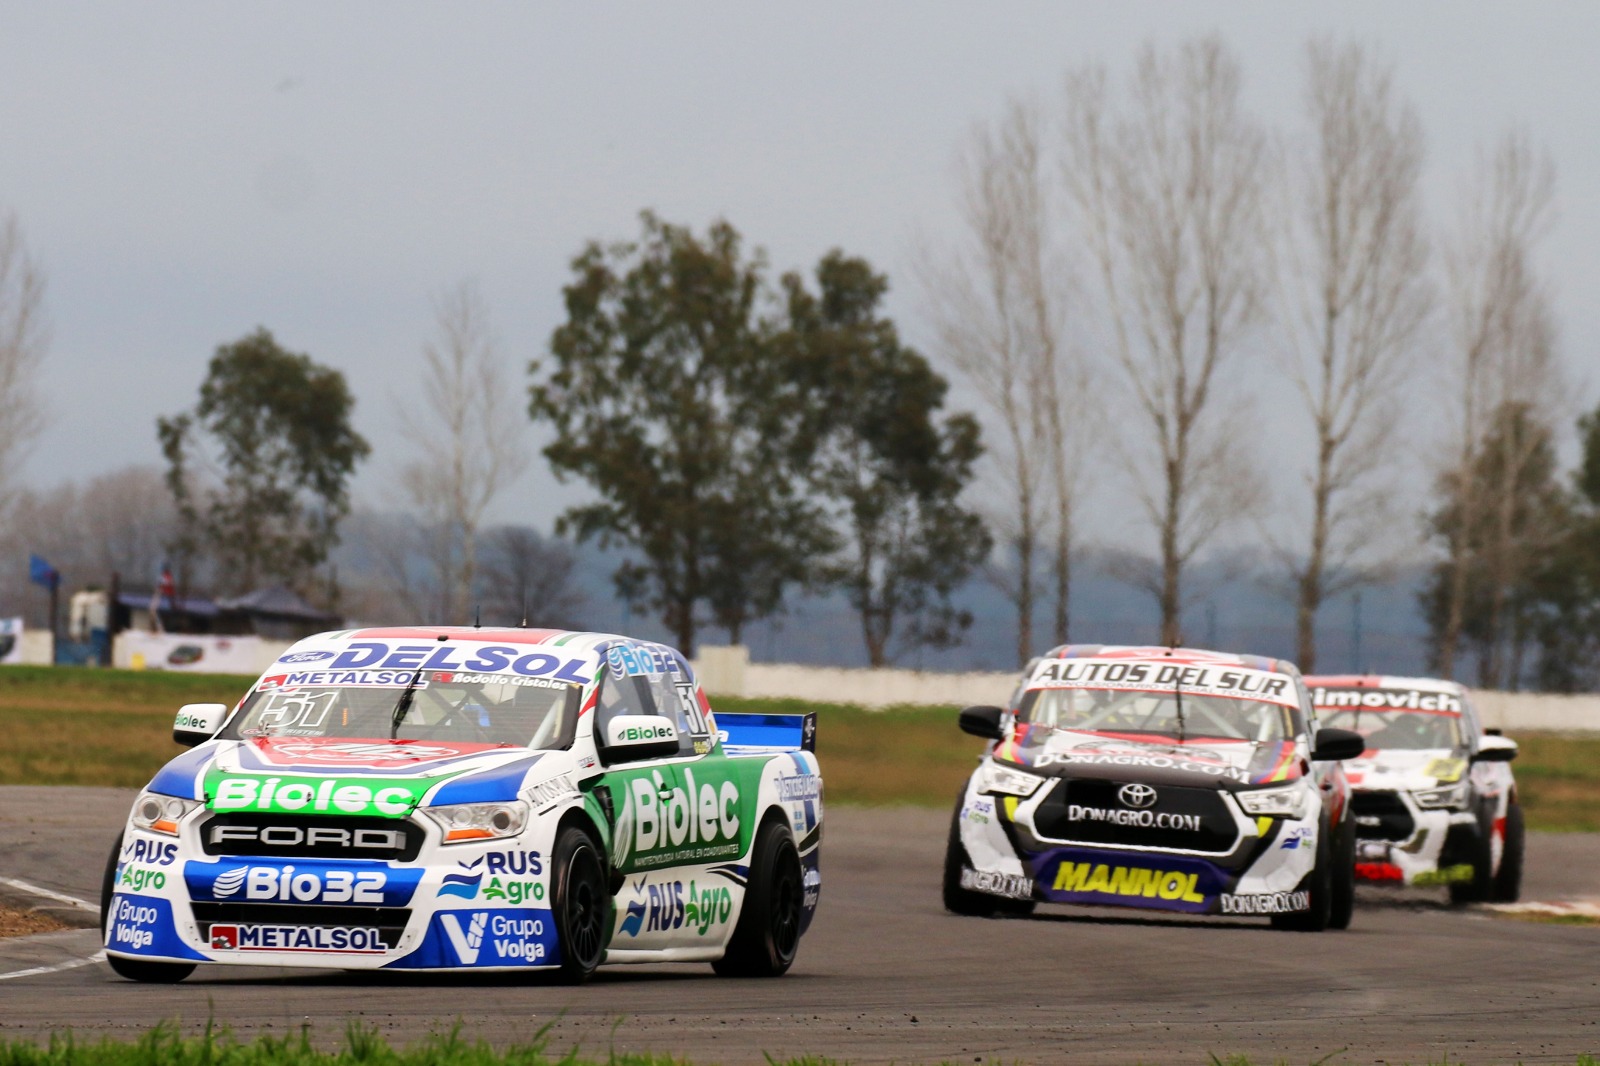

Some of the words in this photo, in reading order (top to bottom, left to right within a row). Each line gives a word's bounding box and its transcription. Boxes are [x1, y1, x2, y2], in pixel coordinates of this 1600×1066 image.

[286, 651, 323, 663] Ford
[329, 643, 591, 684] DELSOL
[287, 672, 426, 685] METALSOL
[452, 673, 507, 685] Rodolfo
[511, 676, 567, 691] Cristales
[1035, 664, 1151, 682] AUTOS
[1154, 666, 1208, 686] DEL
[1216, 672, 1287, 696] SUR
[1162, 684, 1213, 694] OICIAL
[258, 691, 338, 728] 51
[677, 685, 707, 734] 51
[1309, 687, 1462, 712] imovich
[626, 726, 673, 741] Biolec
[1033, 752, 1251, 784] DONAGRO.COM
[213, 777, 414, 816] Biolec
[632, 767, 740, 852] Biolec
[1068, 804, 1201, 831] DONAGRO.COM
[210, 825, 407, 850] FORD
[134, 839, 178, 866] RUS
[486, 850, 543, 876] RUS
[123, 864, 166, 891] Agro
[246, 865, 387, 902] Bio32
[482, 877, 544, 904] Agro
[1053, 861, 1204, 903] MANNOL
[119, 900, 158, 927] Grupo
[646, 880, 685, 932] RUS
[685, 879, 731, 936] Agro
[116, 923, 154, 949] Volga
[239, 927, 387, 950] METALSOL
[491, 915, 544, 939] Grupo
[494, 939, 545, 962] Volga
